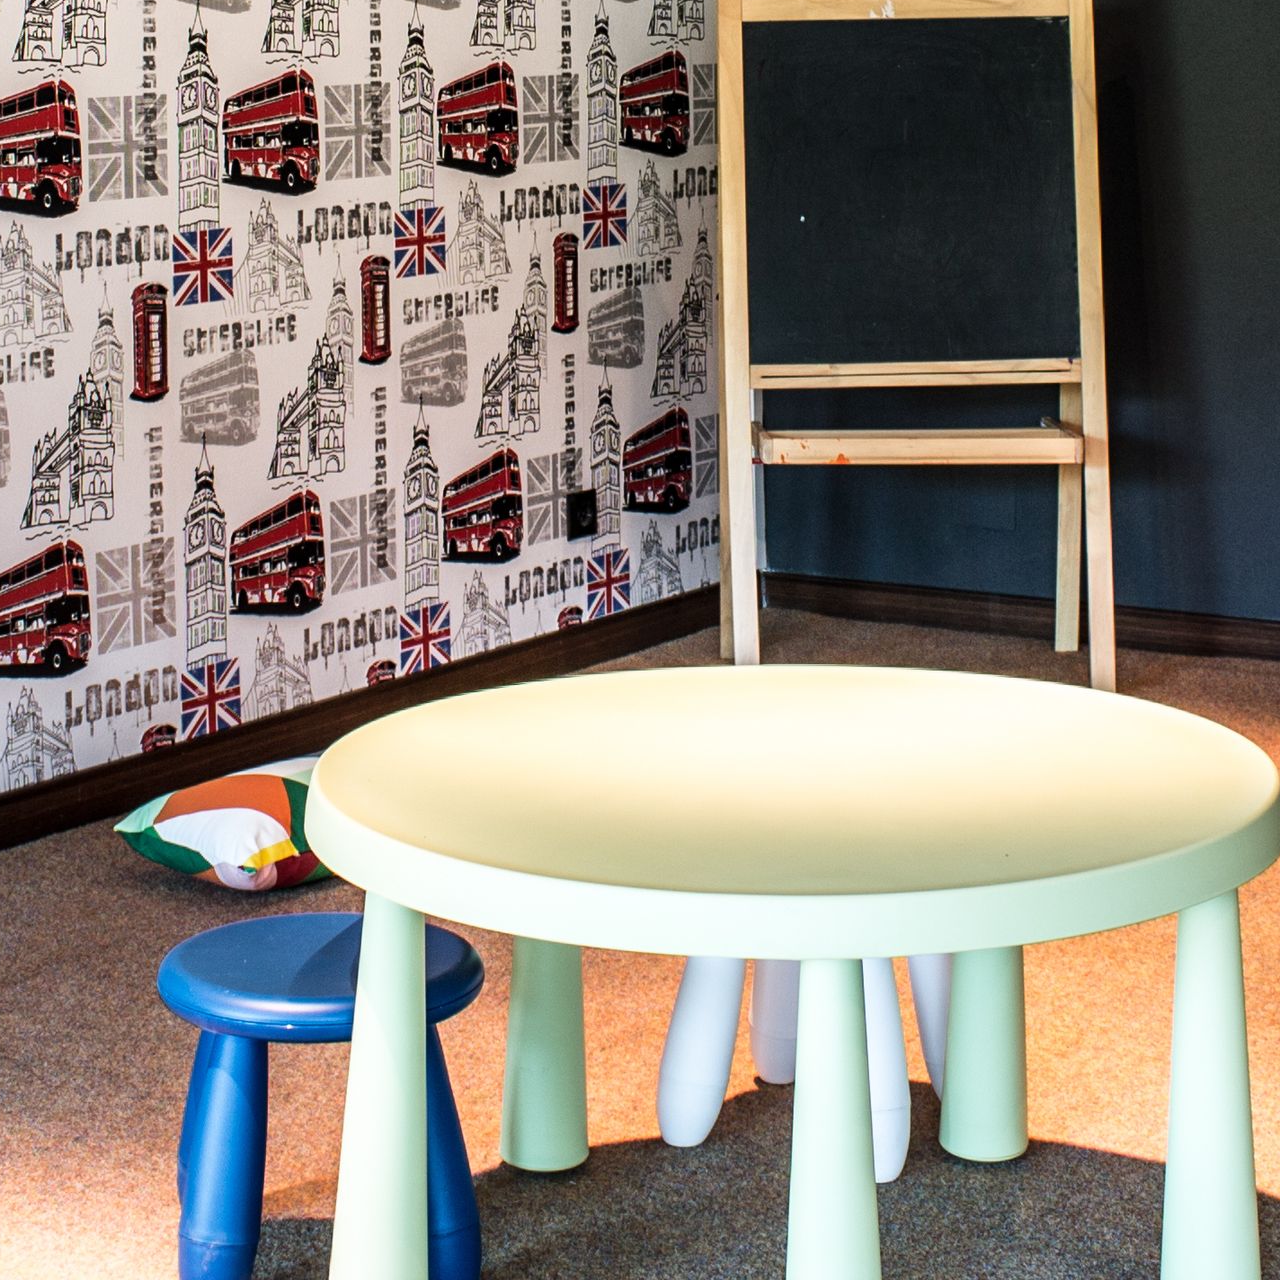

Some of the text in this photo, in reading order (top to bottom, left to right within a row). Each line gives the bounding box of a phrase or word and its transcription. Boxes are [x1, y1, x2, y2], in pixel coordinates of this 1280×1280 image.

[296, 201, 392, 245] London
[499, 182, 581, 222] London
[55, 223, 169, 271] London
[503, 554, 585, 607] London
[302, 604, 398, 663] London
[65, 662, 178, 729] London
